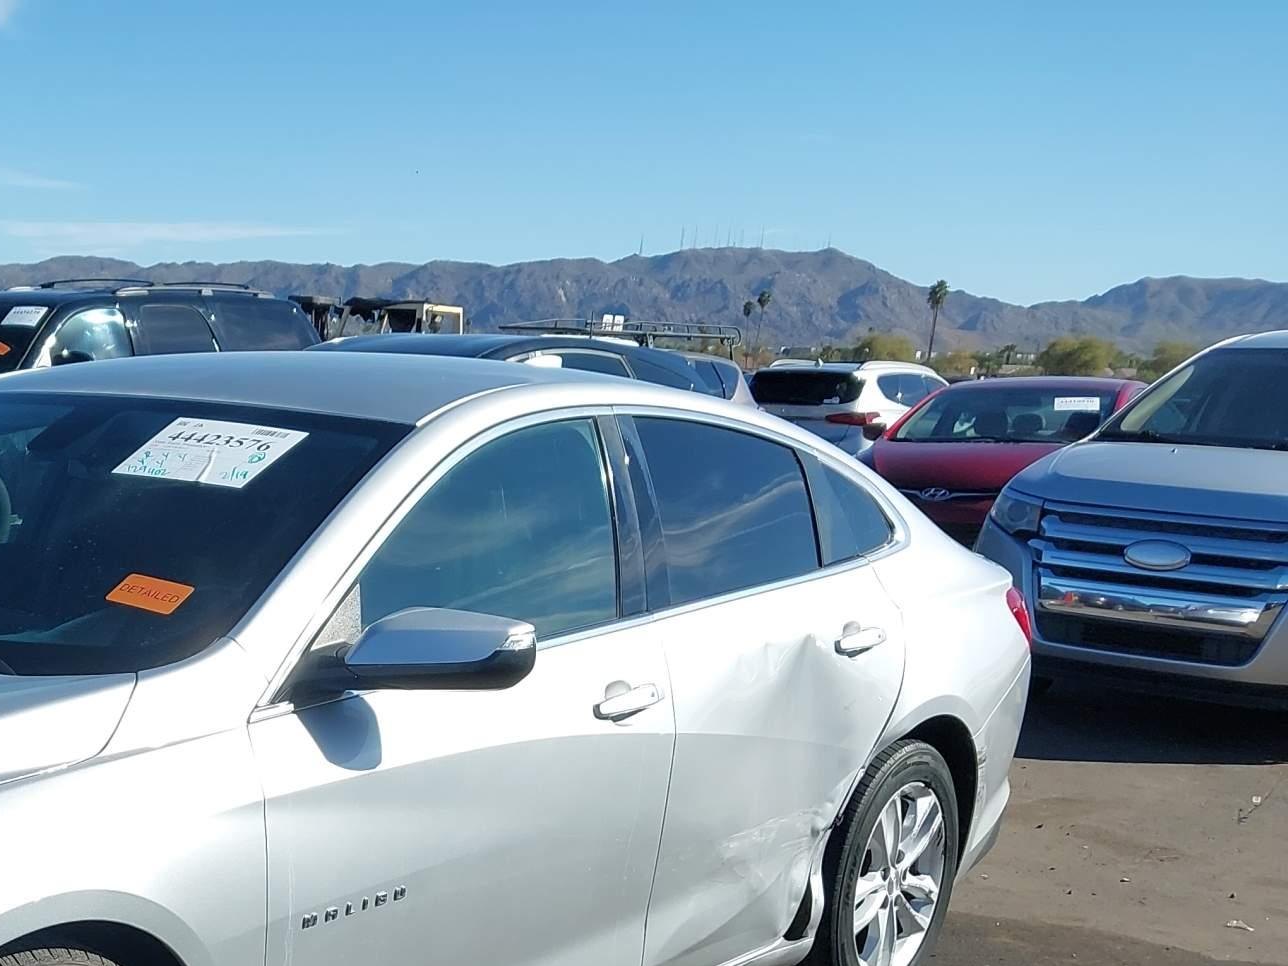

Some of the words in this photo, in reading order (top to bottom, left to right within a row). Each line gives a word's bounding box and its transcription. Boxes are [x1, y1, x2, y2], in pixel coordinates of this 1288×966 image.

[168, 430, 273, 452] 44423576
[119, 583, 180, 603] DETAILED
[301, 885, 407, 929] MALIBU
